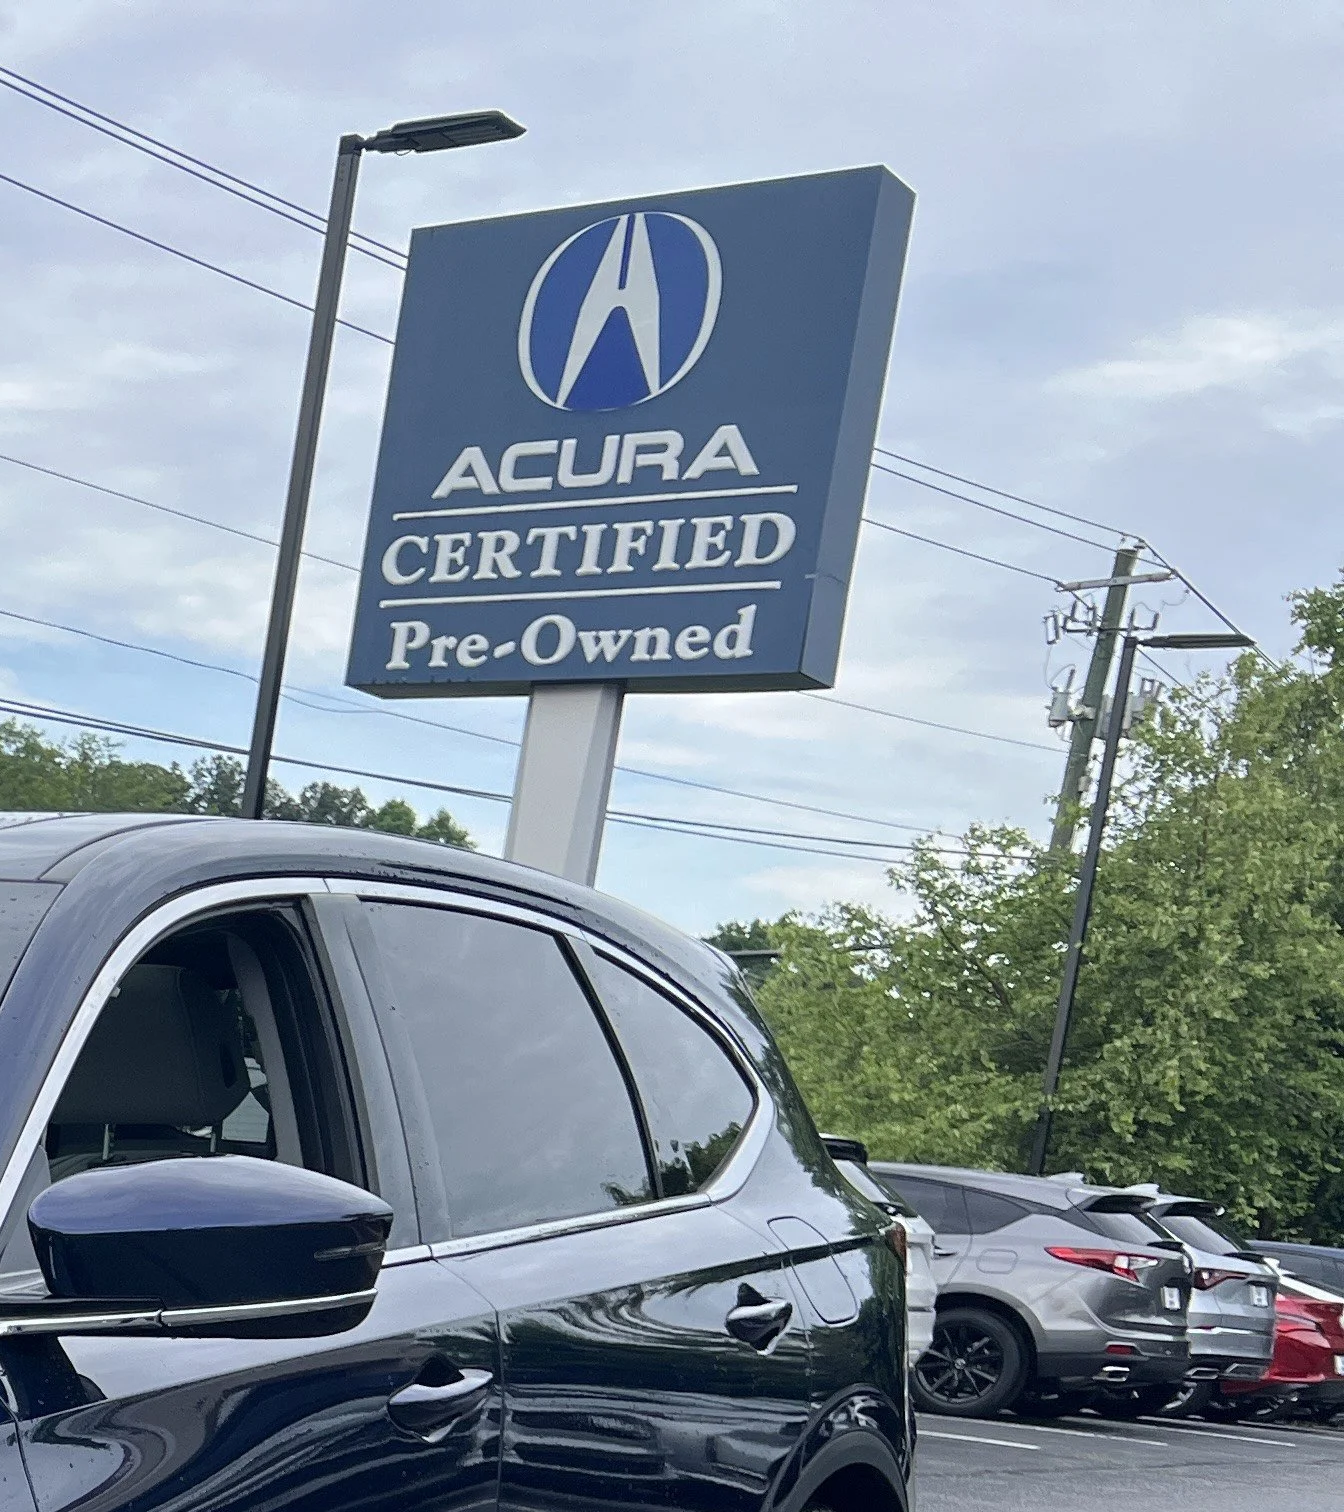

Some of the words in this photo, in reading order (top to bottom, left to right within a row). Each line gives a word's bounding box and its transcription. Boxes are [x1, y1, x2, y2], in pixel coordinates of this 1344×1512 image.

[431, 423, 761, 500] ACURA
[380, 511, 798, 587] CERTIFIED
[385, 603, 758, 670] Pre-Owned
